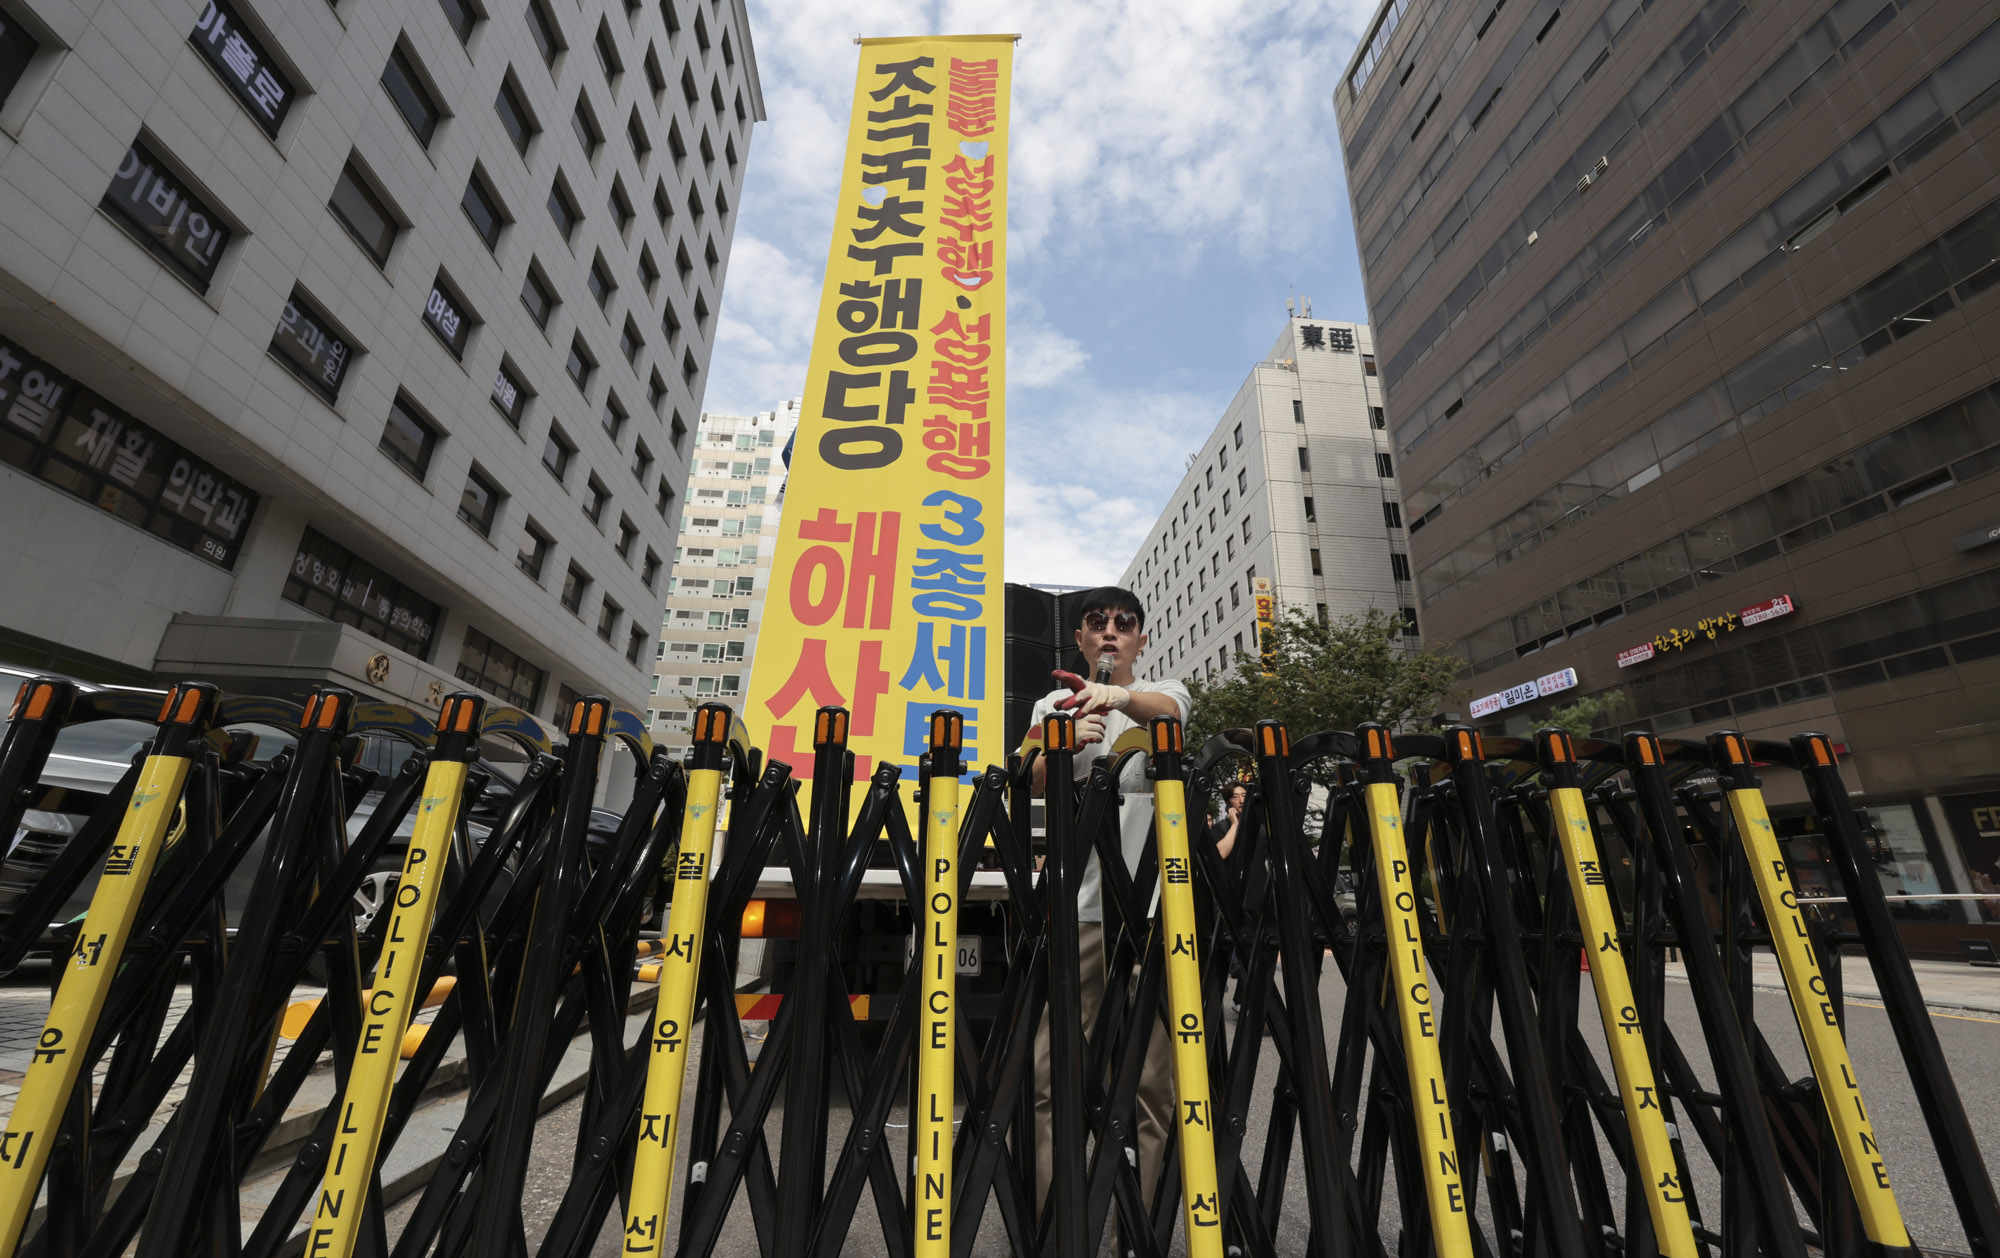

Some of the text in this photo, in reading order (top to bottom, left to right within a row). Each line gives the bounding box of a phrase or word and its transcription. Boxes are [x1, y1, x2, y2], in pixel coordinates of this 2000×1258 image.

[196, 0, 518, 409] 아폴로 여성 의원
[1300, 324, 1355, 351] 東亞
[203, 540, 227, 561] 의원
[764, 56, 937, 782] 조국추행당 해산
[1653, 628, 1695, 651] 한국의
[1771, 597, 1785, 607] 2F
[308, 848, 427, 1258] POLICE LINE
[626, 852, 705, 1253] 질서유지선
[925, 858, 951, 1241] POLICE LINE
[1164, 857, 1219, 1227] 질서유지선
[1392, 859, 1463, 1213] POLICE LINE
[1771, 860, 1890, 1189] POLICE LINE
